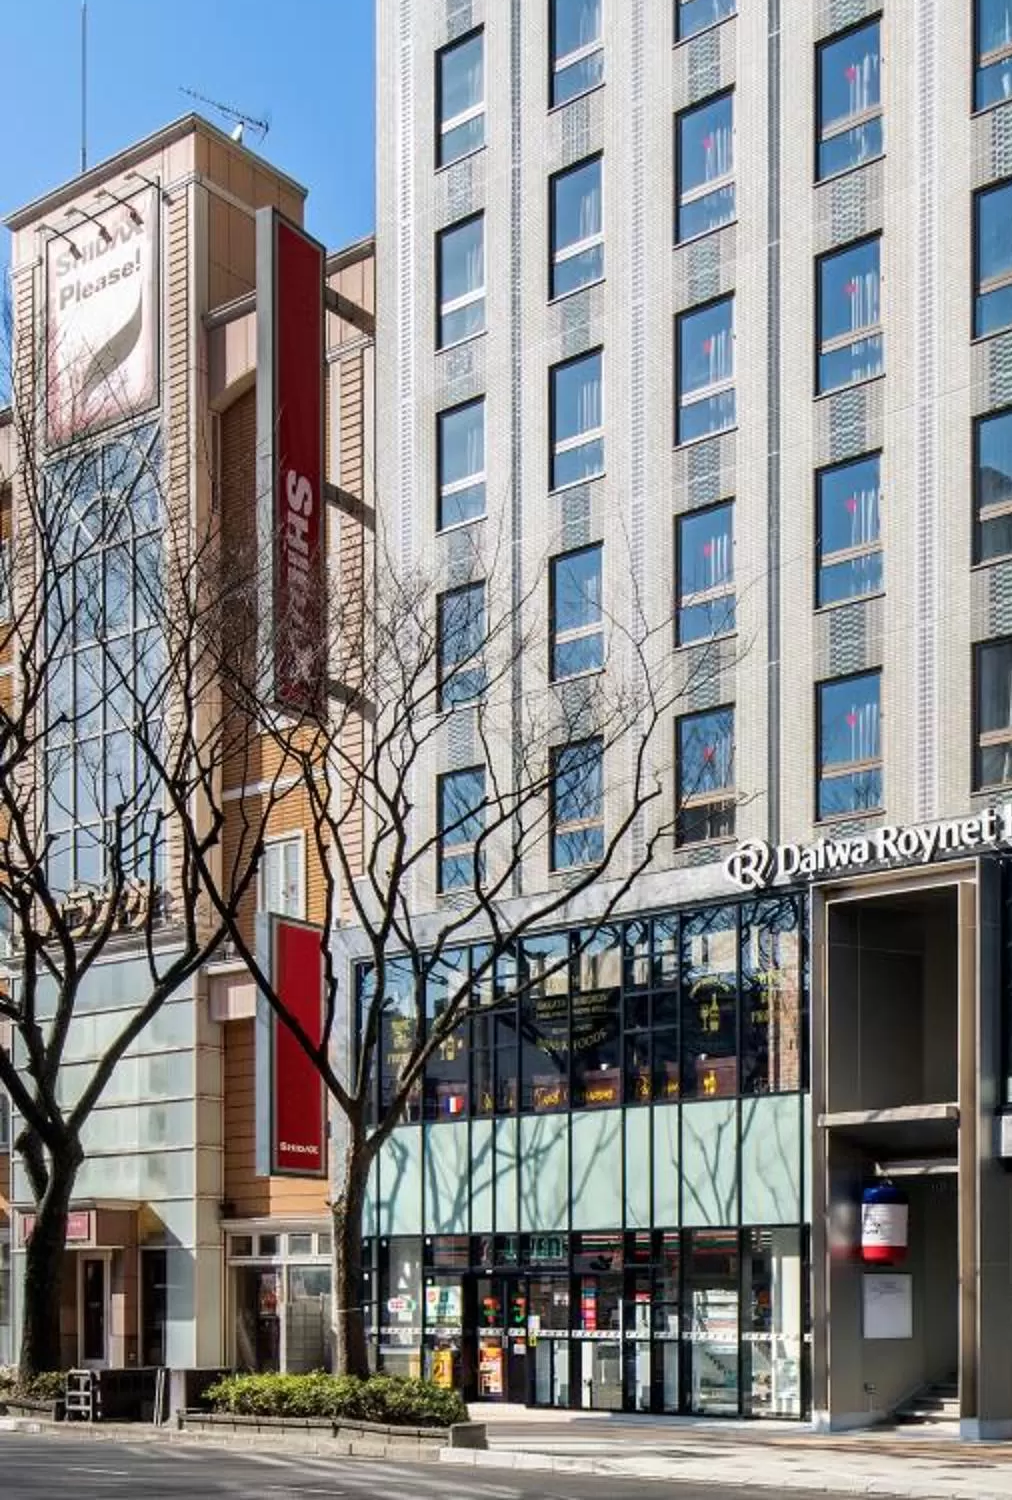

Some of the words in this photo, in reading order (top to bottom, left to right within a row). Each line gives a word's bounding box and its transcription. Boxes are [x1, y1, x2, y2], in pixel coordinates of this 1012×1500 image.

[60, 247, 141, 311] Please!
[776, 834, 869, 877] Daiwa
[875, 810, 998, 862] Roynet
